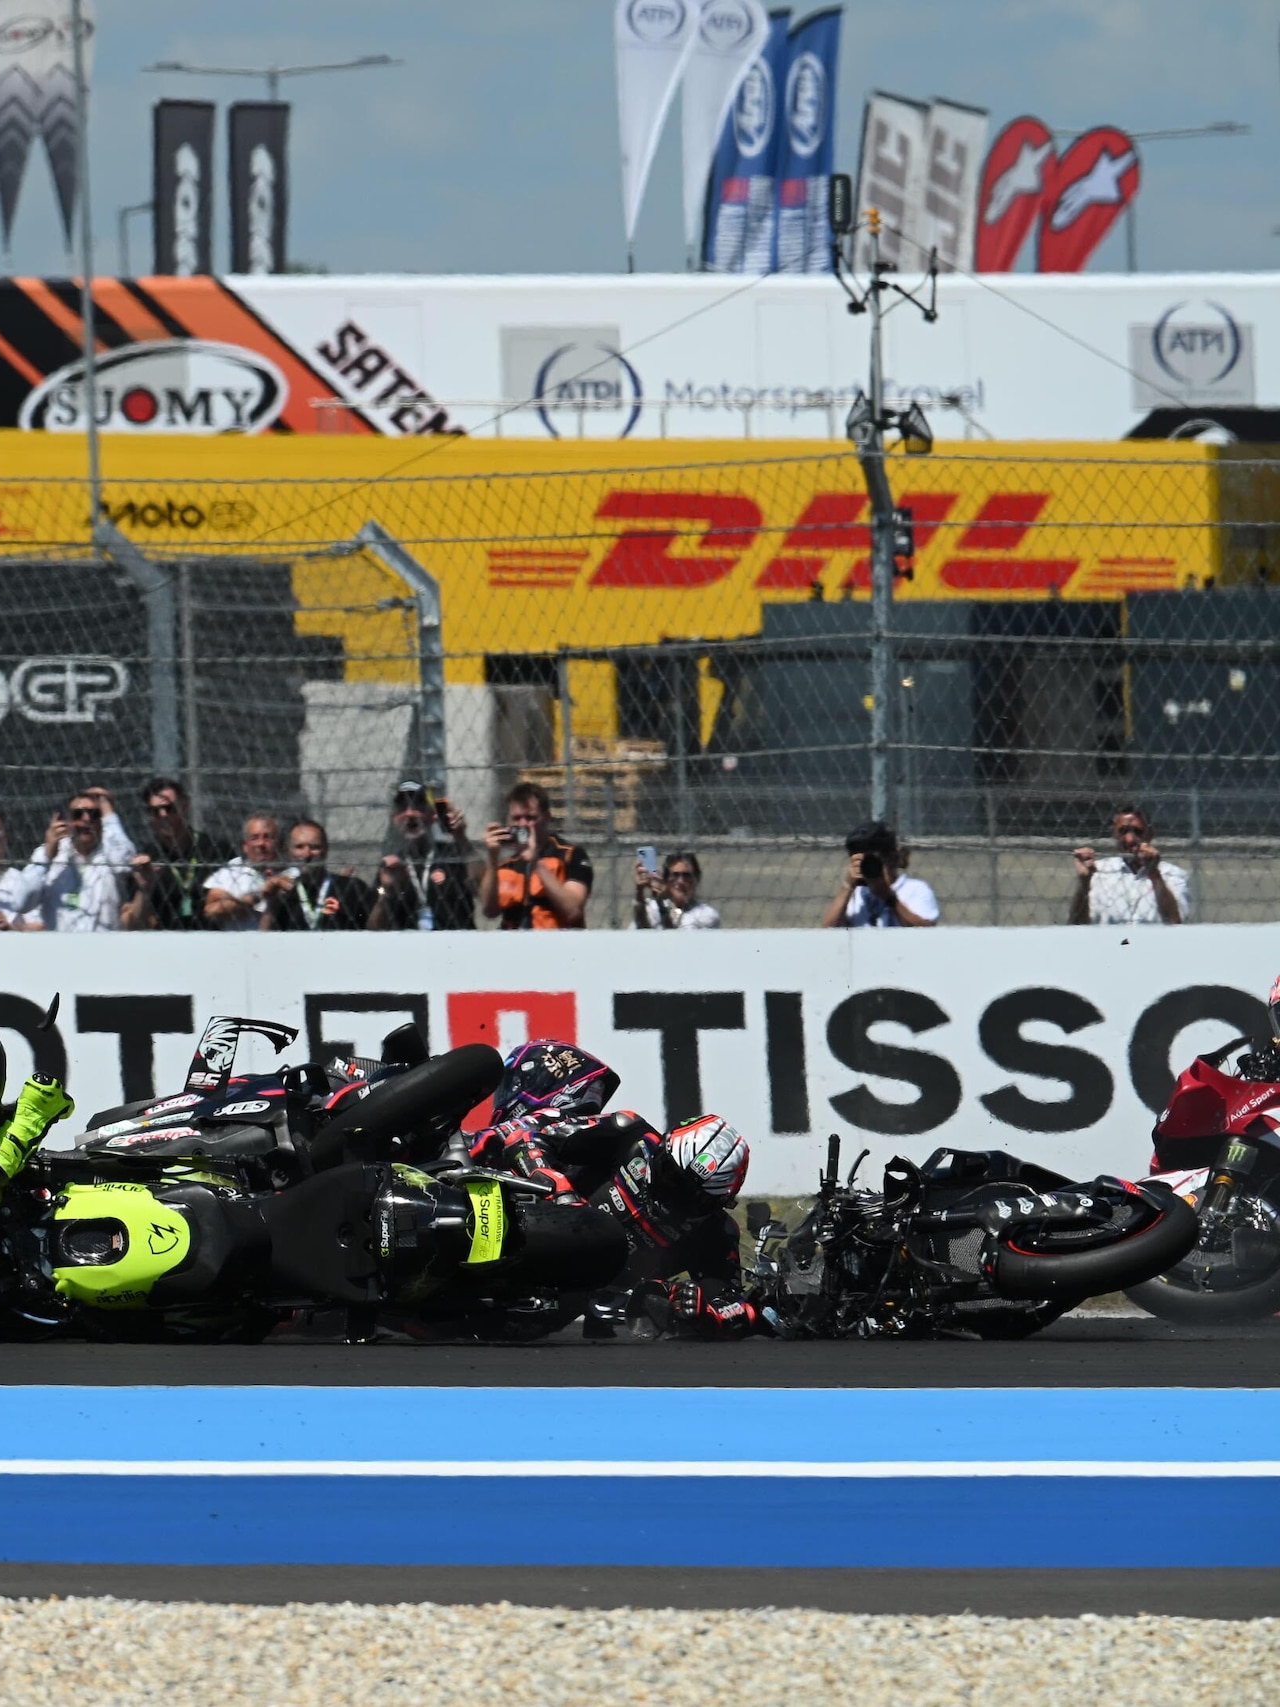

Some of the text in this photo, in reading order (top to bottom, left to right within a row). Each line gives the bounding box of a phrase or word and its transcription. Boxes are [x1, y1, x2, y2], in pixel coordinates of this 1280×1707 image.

[1170, 330, 1226, 355] ATPI
[590, 492, 1079, 589] DHL
[189, 1071, 223, 1085] SC
[1230, 1087, 1276, 1122] Audi Sport
[478, 1198, 492, 1260] SuperFile
